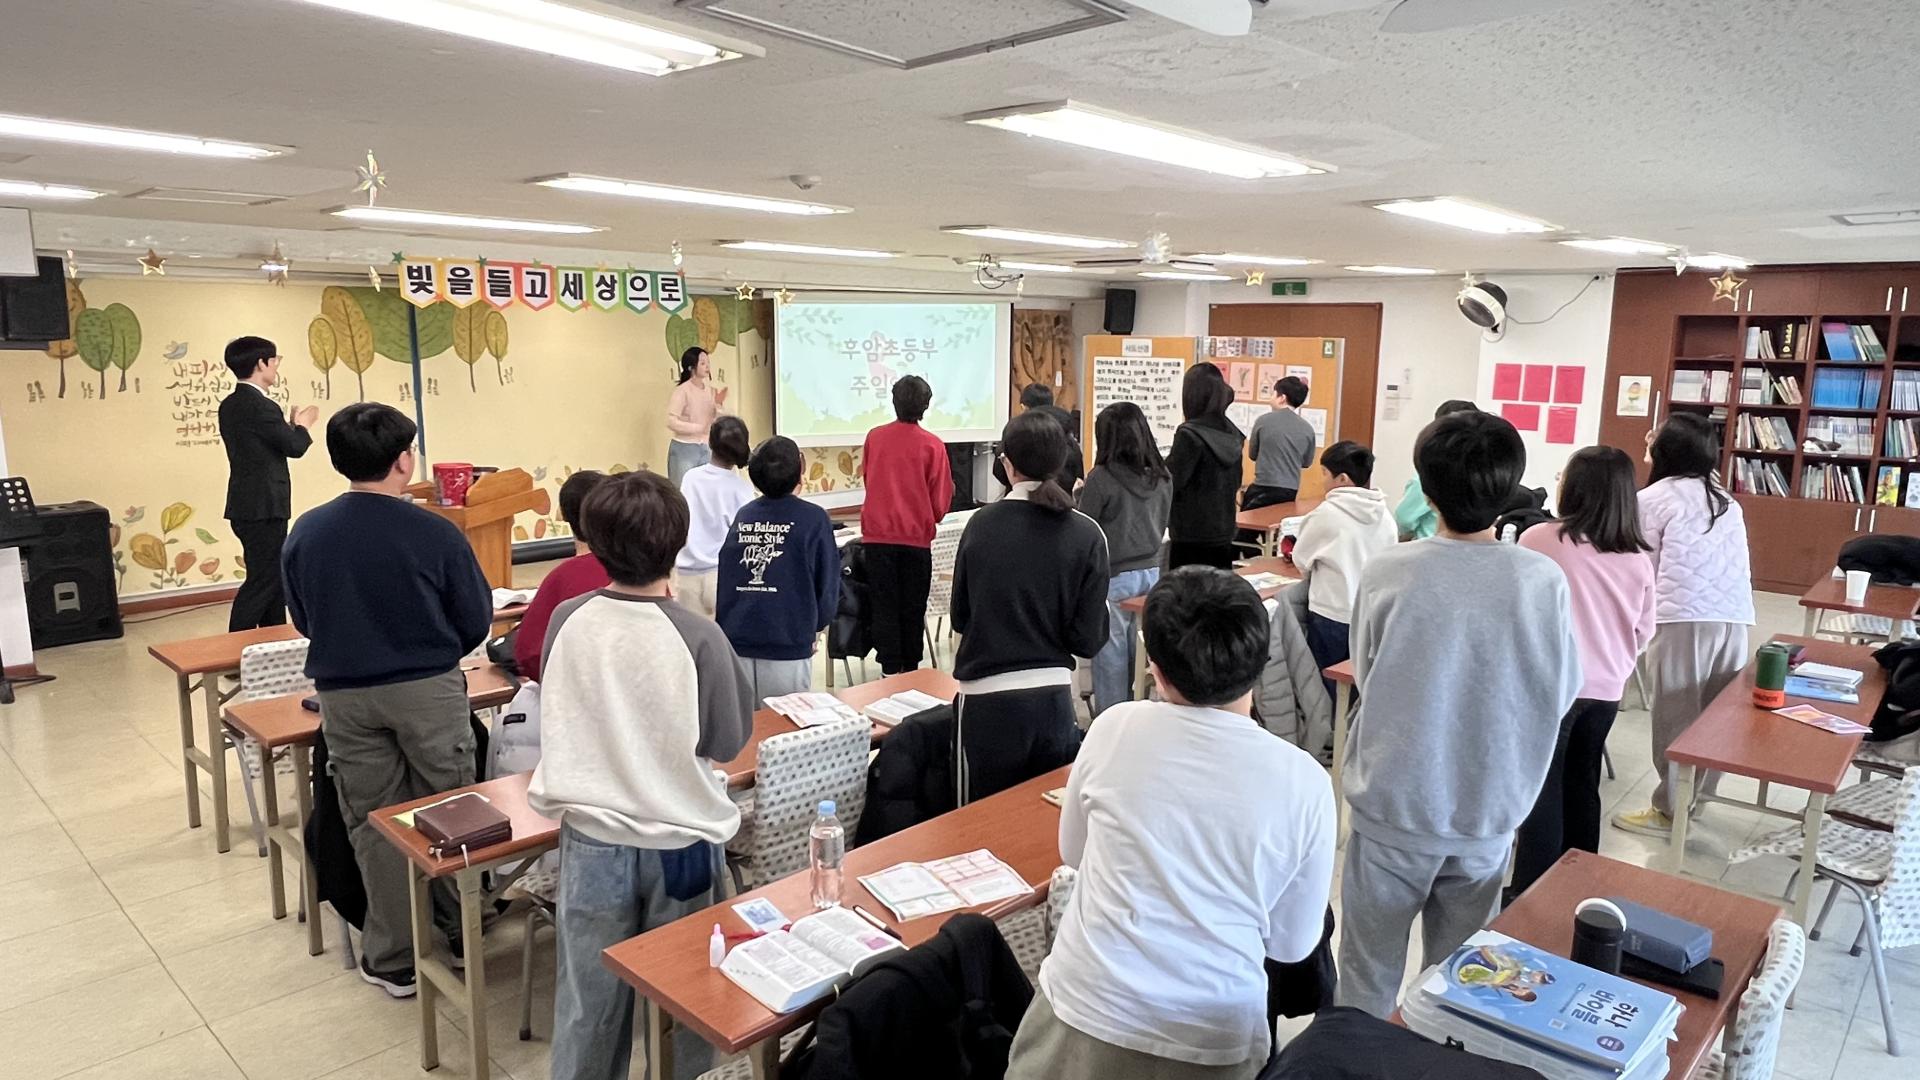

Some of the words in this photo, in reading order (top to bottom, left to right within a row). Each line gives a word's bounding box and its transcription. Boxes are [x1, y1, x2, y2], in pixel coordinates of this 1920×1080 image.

[841, 338, 938, 363] 후암초등부
[737, 521, 754, 532] New
[754, 521, 791, 533] Balance
[738, 532, 762, 543] Iconic
[763, 532, 785, 546] Style
[1571, 989, 1616, 1025] 바이블
[1604, 1002, 1640, 1029] 하나
